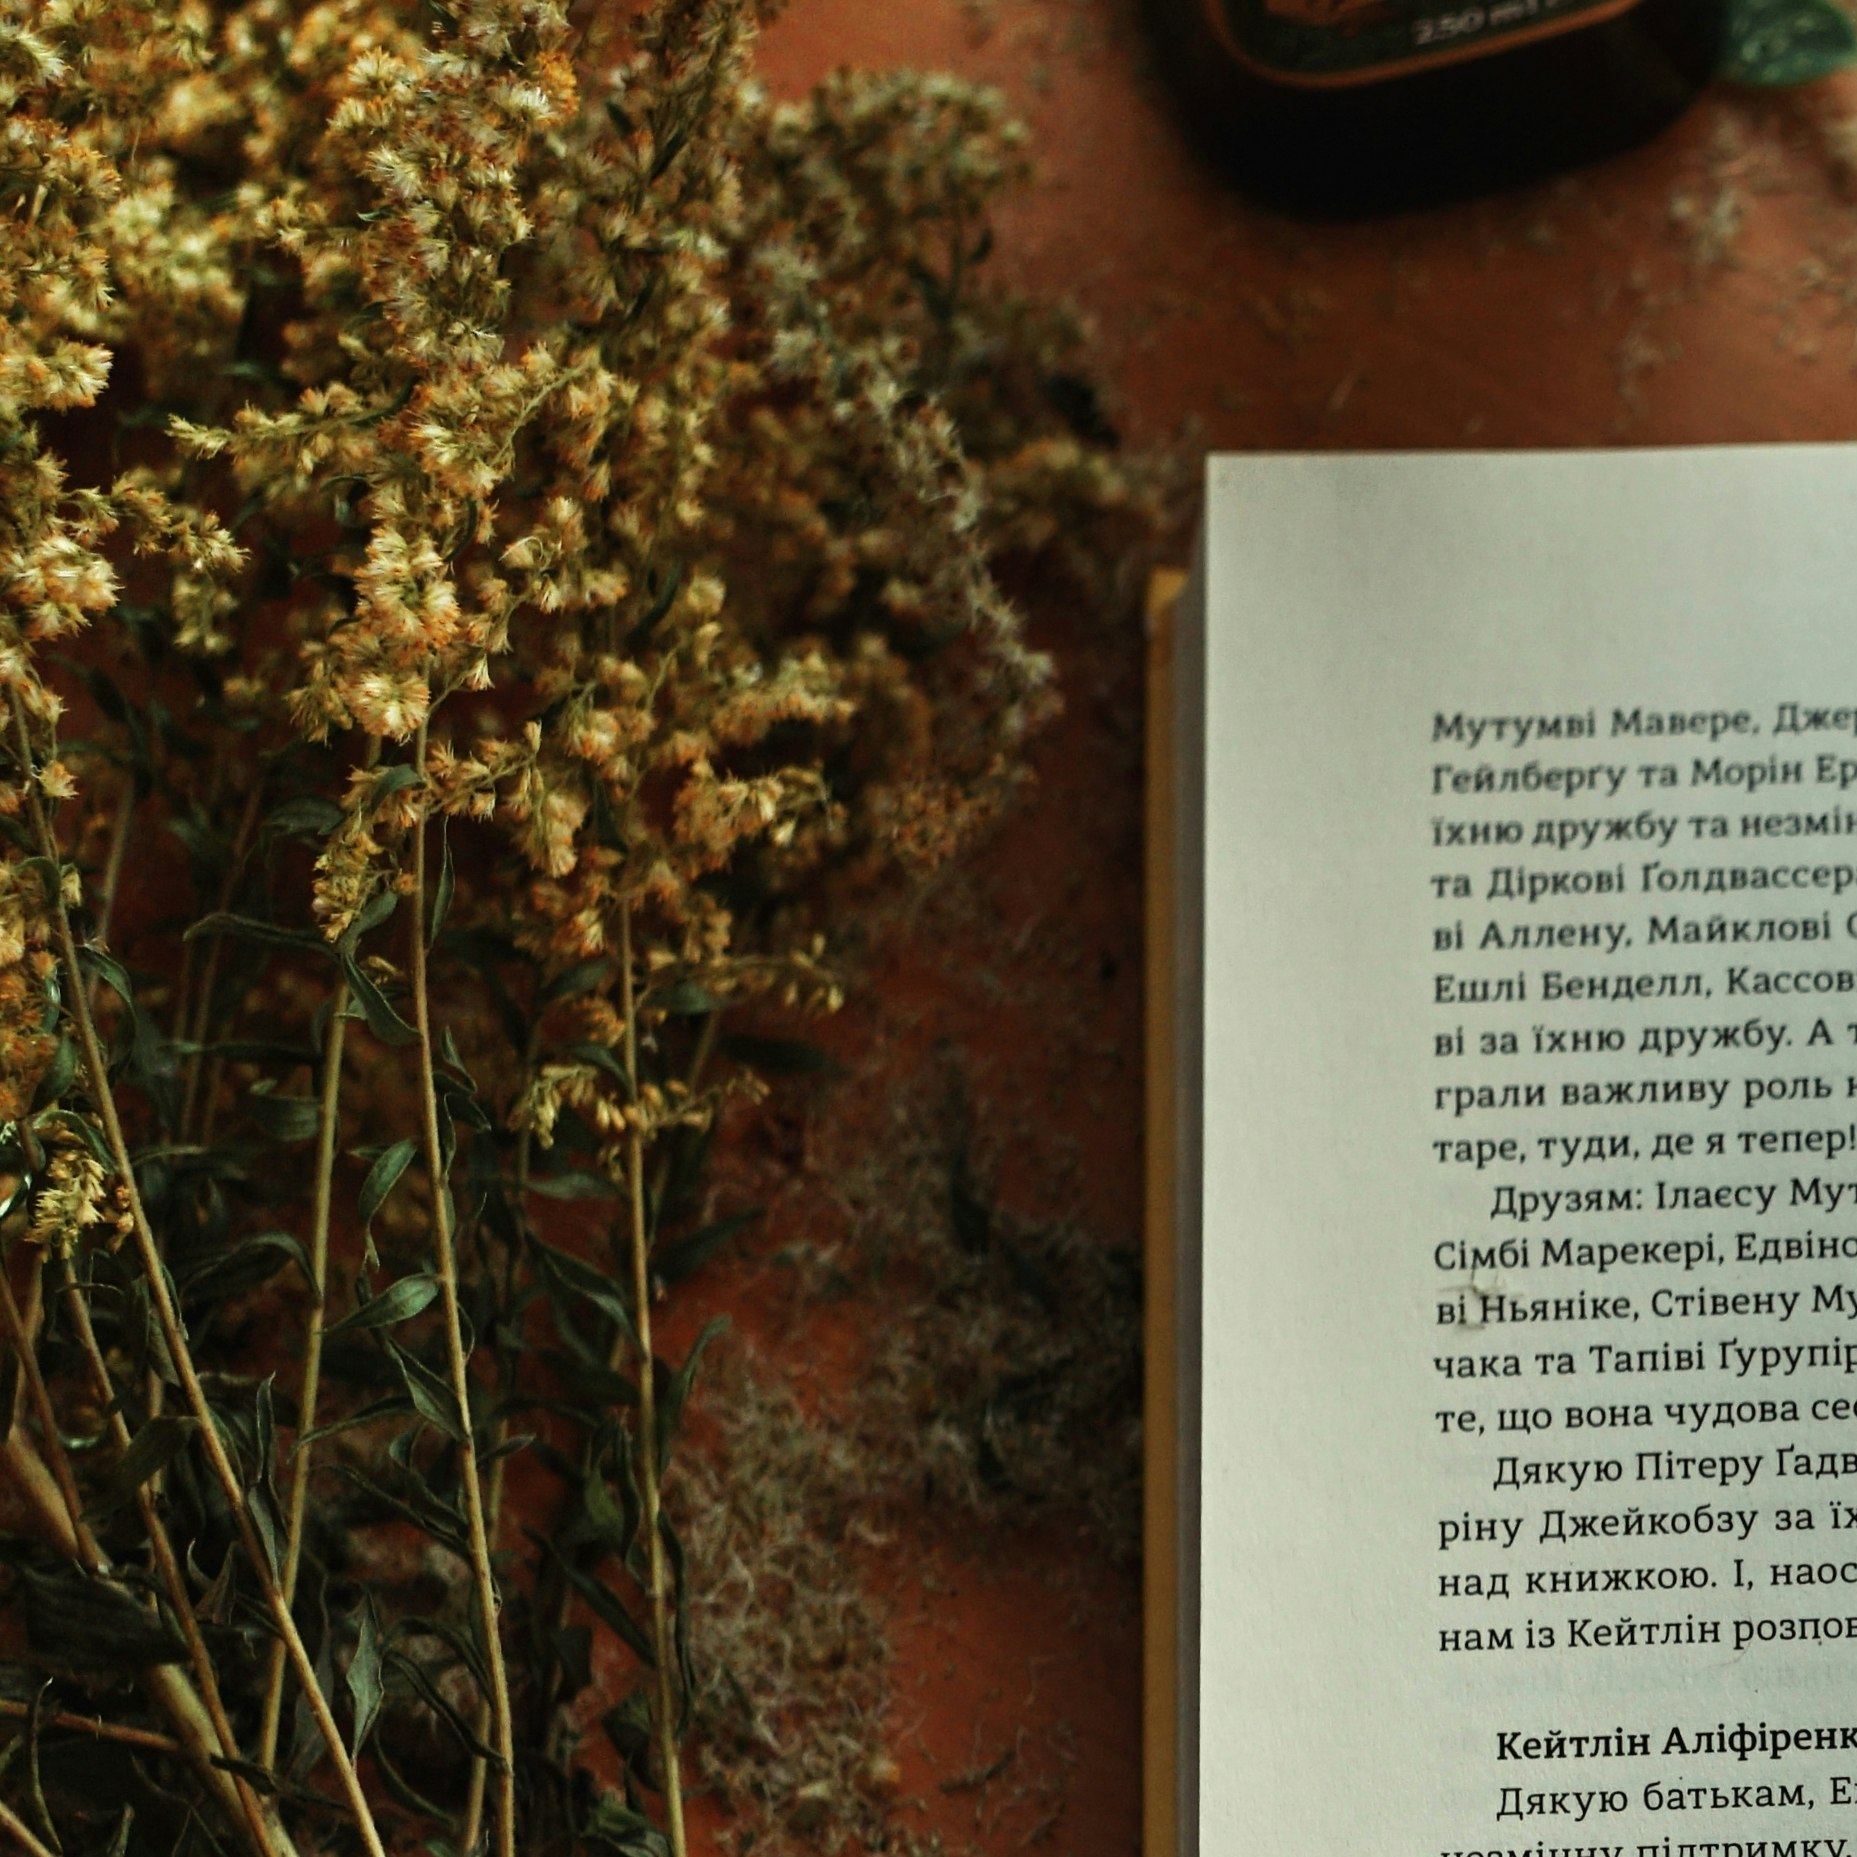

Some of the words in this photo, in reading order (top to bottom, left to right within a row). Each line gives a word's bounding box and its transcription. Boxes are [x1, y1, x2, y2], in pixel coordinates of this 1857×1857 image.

[1431, 709, 1597, 749] Мутумві
[1610, 706, 1760, 742] Мавере,
[1429, 874, 1473, 899] та
[1485, 863, 1626, 904] Діркові
[1433, 970, 1527, 1005] Ешлі
[1541, 970, 1713, 1003] Бенделл,
[1434, 1025, 1465, 1058] ві
[1479, 1031, 1520, 1056] за
[1531, 1024, 1627, 1055] їхню
[1637, 1017, 1793, 1058] дружбу.
[1806, 1016, 1835, 1047] А
[1431, 1138, 1527, 1171] таре,
[1536, 1134, 1641, 1168] туди,
[1650, 1132, 1695, 1161] де
[1705, 1131, 1726, 1156] я
[1736, 1122, 1857, 1161] тепер!
[1433, 1237, 1531, 1271] Сімбі
[1540, 1231, 1726, 1275] Марекері,
[1434, 1409, 1486, 1437] те,
[1496, 1406, 1554, 1435] що
[1564, 1403, 1654, 1430] вона
[1663, 1399, 1801, 1434] чудова
[1438, 1627, 1515, 1653] нам
[1525, 1618, 1556, 1650] із
[1567, 1613, 1722, 1649] Кейтлін
[1495, 1725, 1652, 1762] Кейтлін
[1495, 1786, 1629, 1823] Дякую
[1642, 1780, 1815, 1812] батькам,
